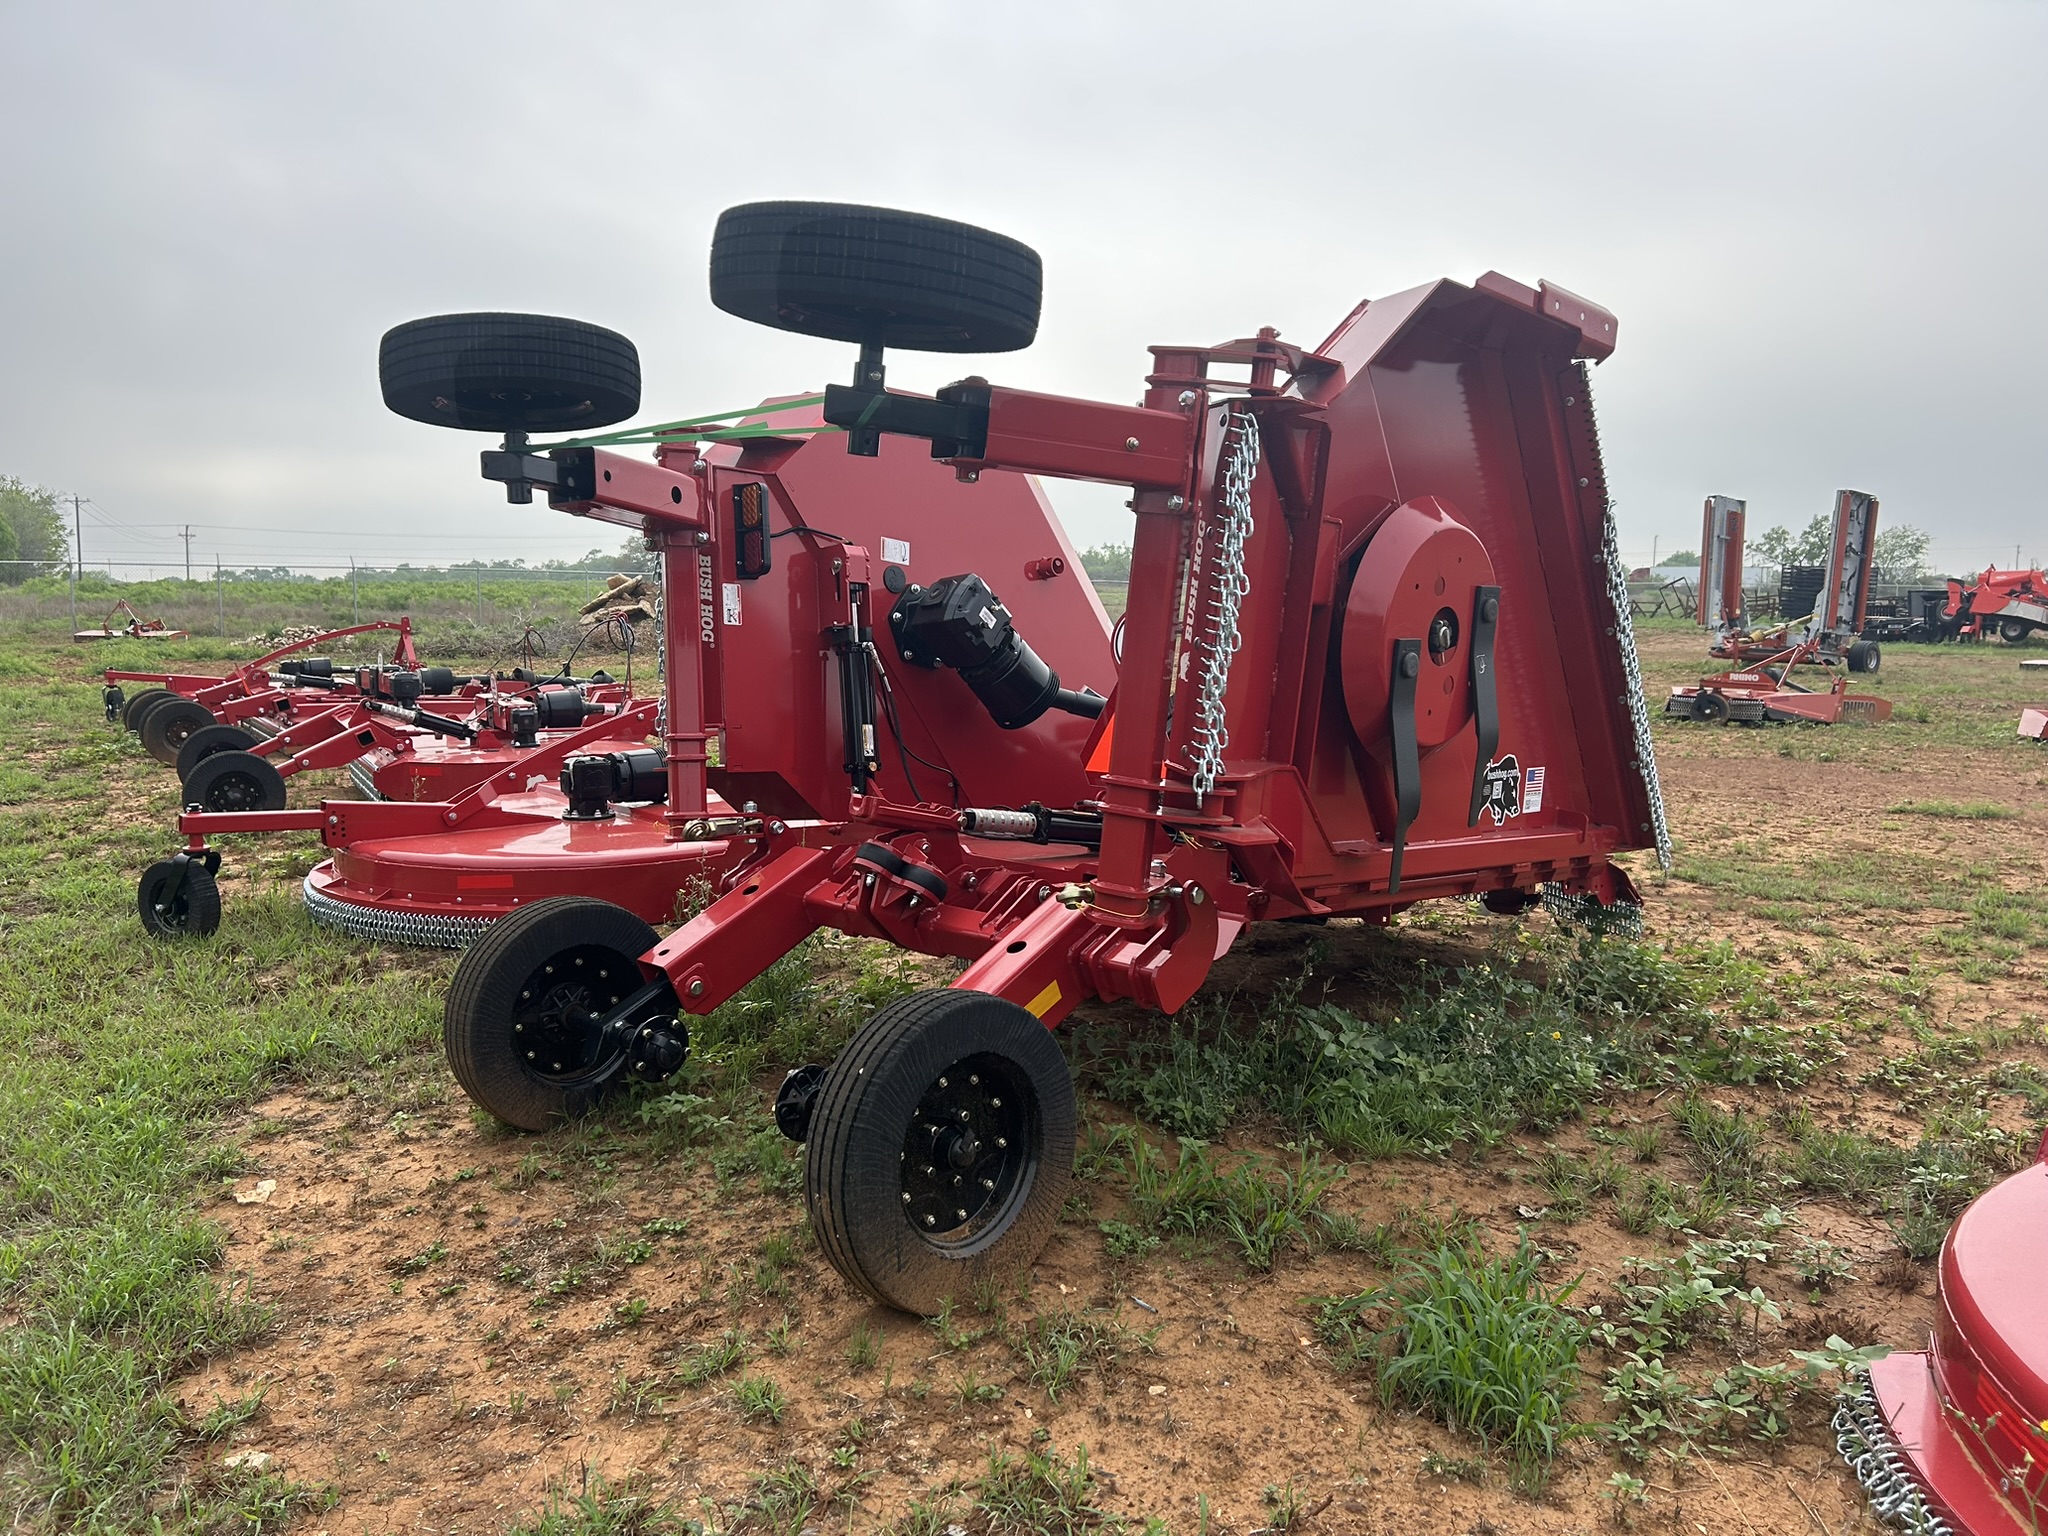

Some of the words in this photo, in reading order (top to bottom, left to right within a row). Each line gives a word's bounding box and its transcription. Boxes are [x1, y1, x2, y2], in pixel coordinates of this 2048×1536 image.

[699, 554, 713, 601] BUSH
[1184, 577, 1199, 643] BUSH
[1193, 519, 1206, 574] HOG
[701, 604, 715, 642] HOG
[1729, 673, 1759, 682] RHINO
[1843, 700, 1876, 719] RHINO
